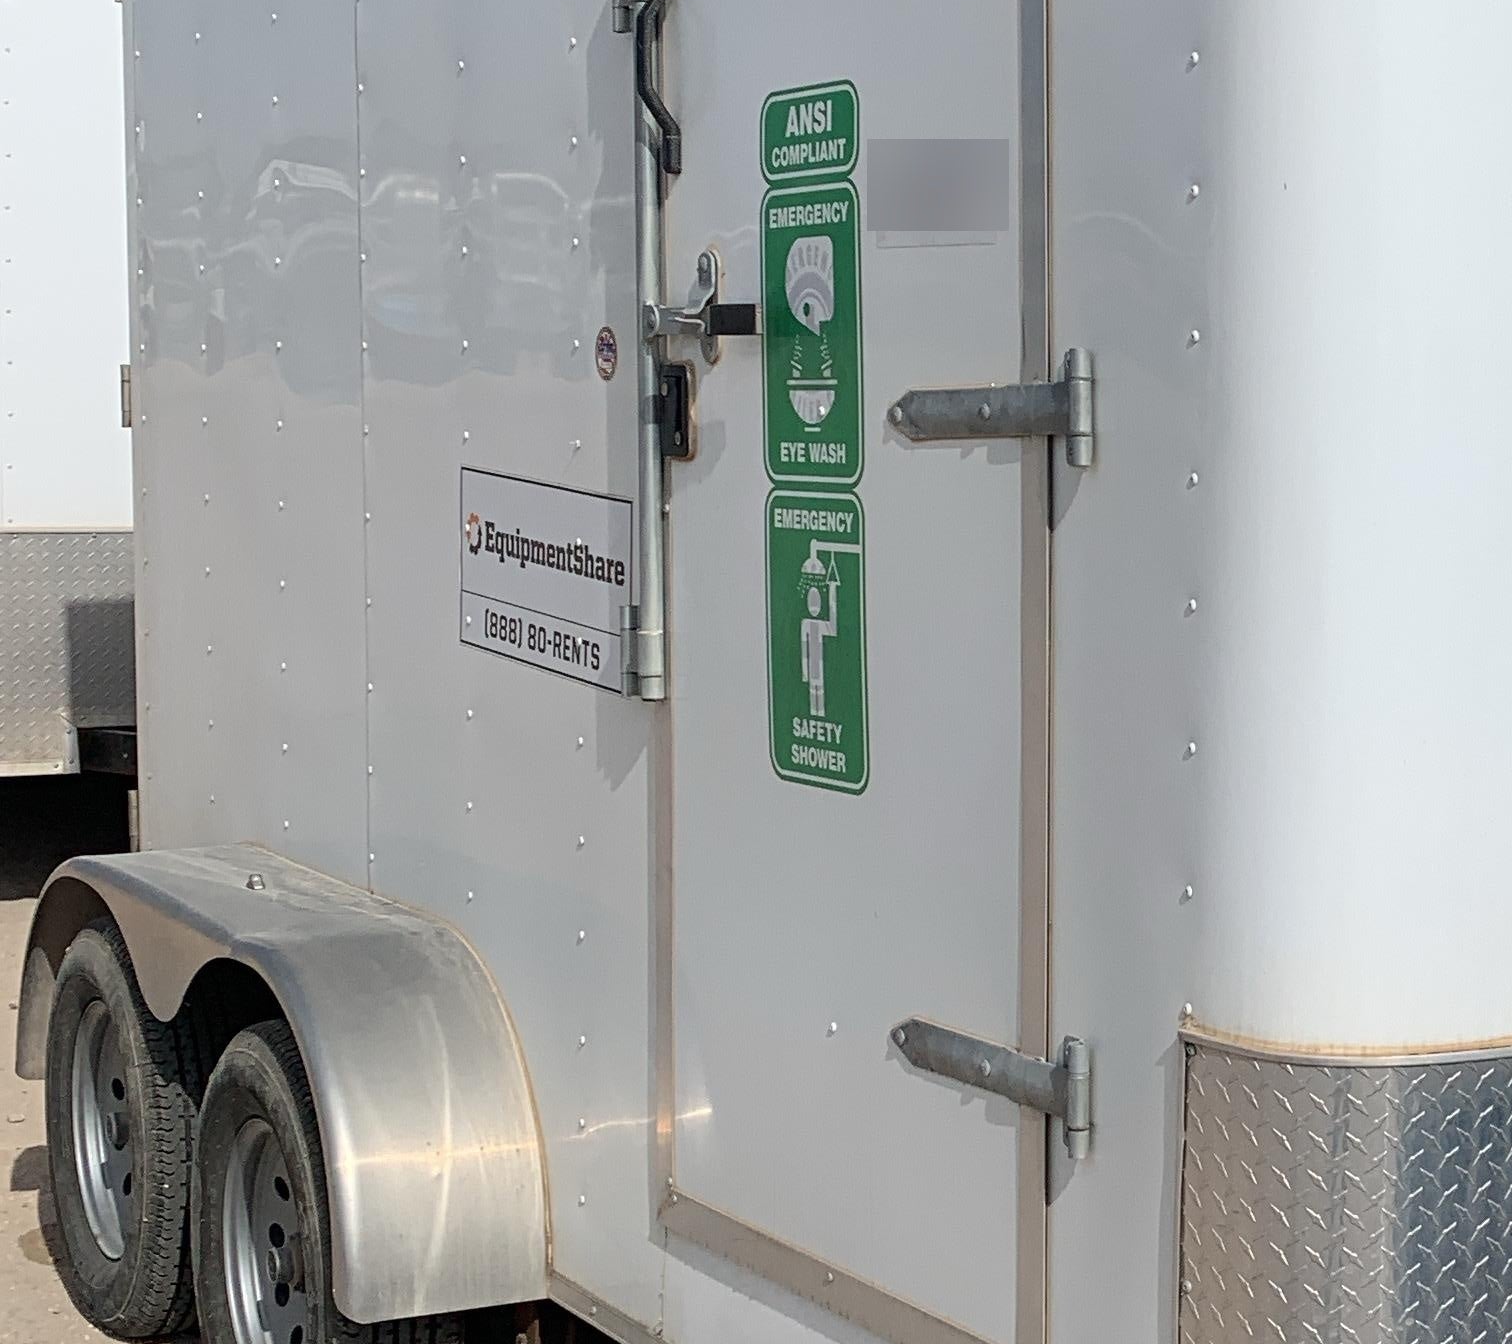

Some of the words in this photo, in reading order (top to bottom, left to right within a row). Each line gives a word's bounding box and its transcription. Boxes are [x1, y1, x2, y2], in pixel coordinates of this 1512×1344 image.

[785, 99, 832, 138] ANSI
[771, 138, 847, 168] COMPLIANT
[769, 201, 849, 229] EMERGENCY
[780, 442, 805, 463] EYE
[809, 443, 846, 464] WASH
[774, 508, 854, 534] EMERGENCY
[484, 520, 625, 587] EquipmentShare
[484, 608, 523, 649] (888)
[528, 623, 601, 671] 80-RENTS
[792, 716, 843, 745] SAFETY
[791, 743, 847, 773] SHOWER
